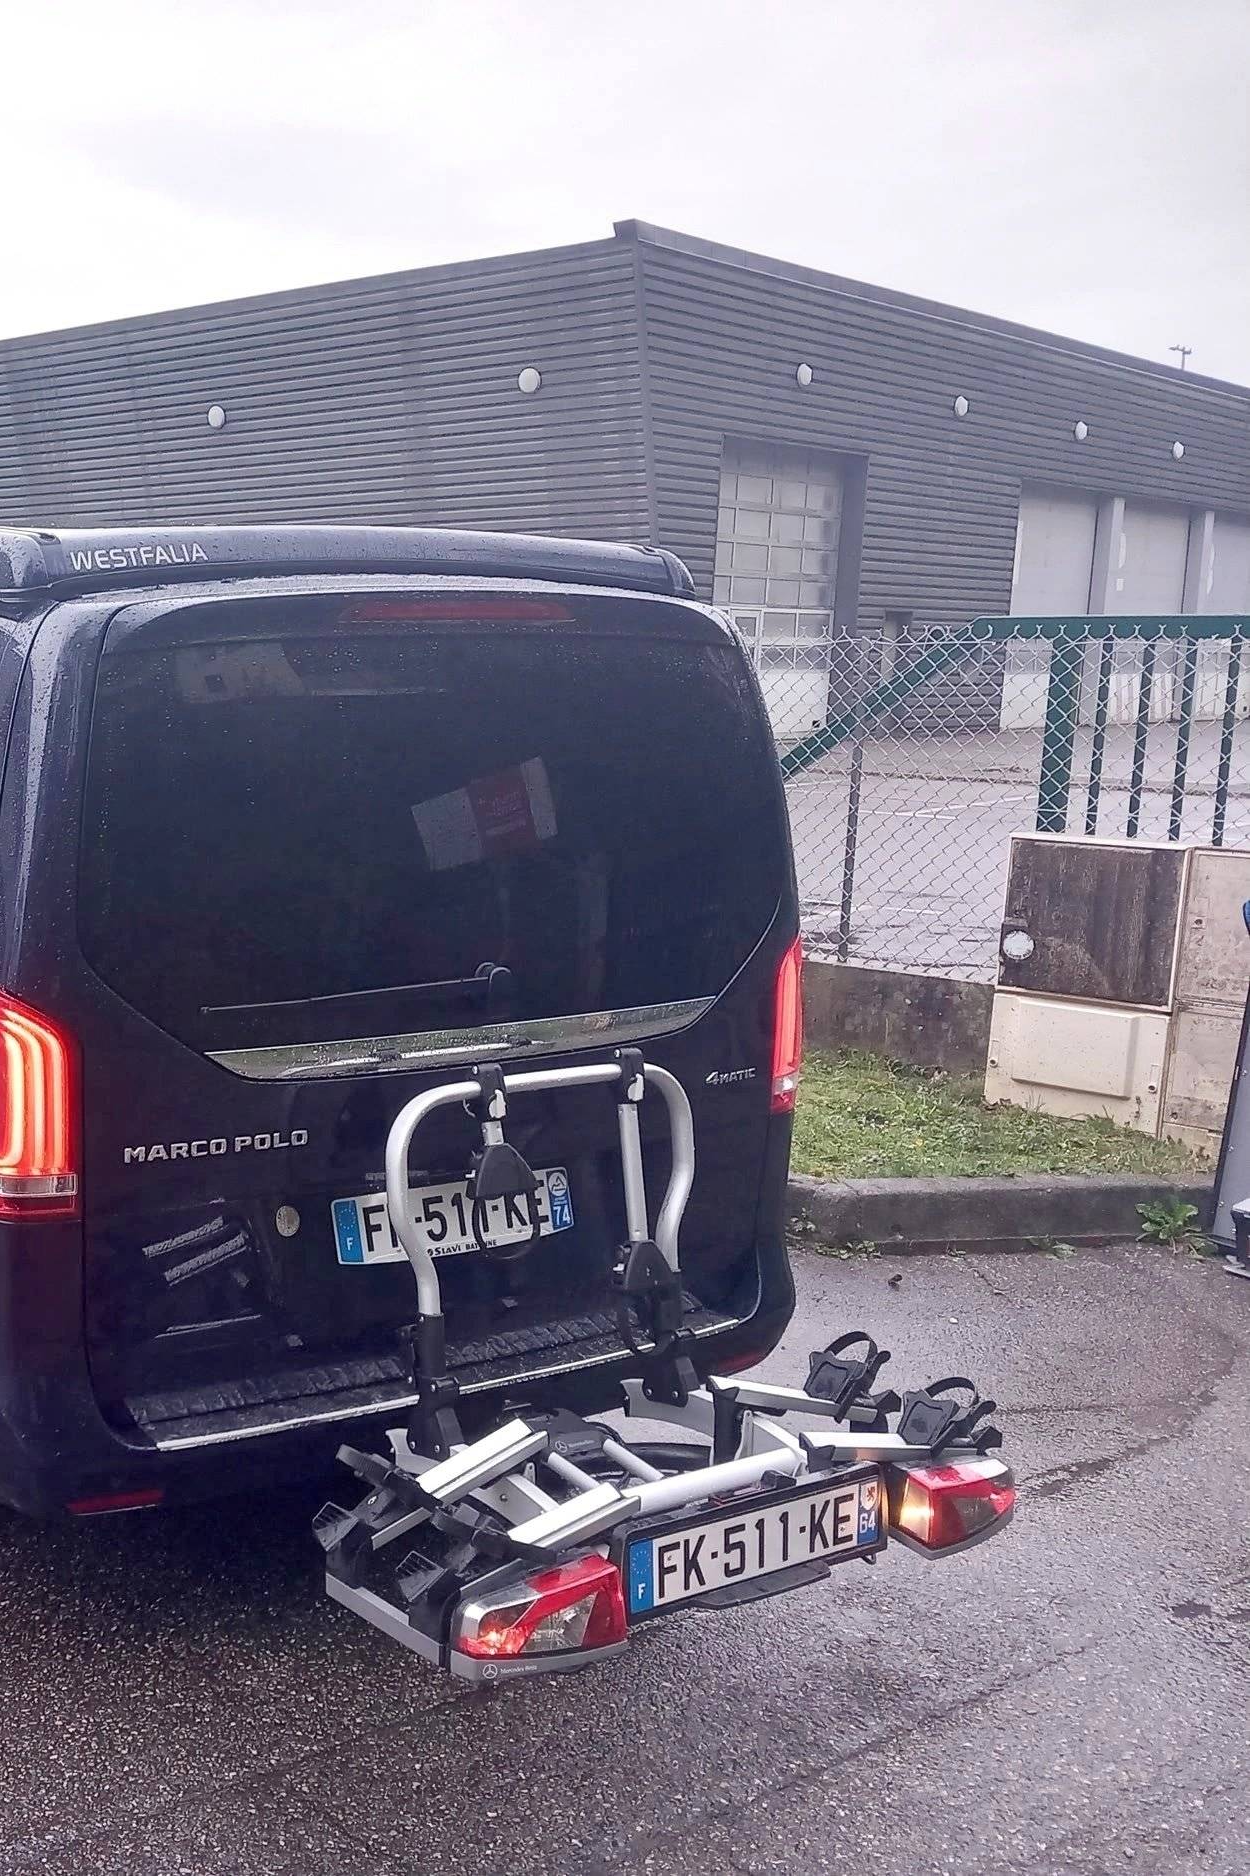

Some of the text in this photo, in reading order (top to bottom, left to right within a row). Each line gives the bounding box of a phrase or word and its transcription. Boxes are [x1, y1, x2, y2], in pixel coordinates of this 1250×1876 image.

[69, 542, 209, 571] WESTFALIA
[705, 1067, 756, 1085] 4MATIC
[123, 1129, 309, 1164] MARCO POLO
[346, 1237, 354, 1251] F
[552, 1203, 571, 1226] 74
[637, 1492, 877, 1601] F FK-511-KE 64
